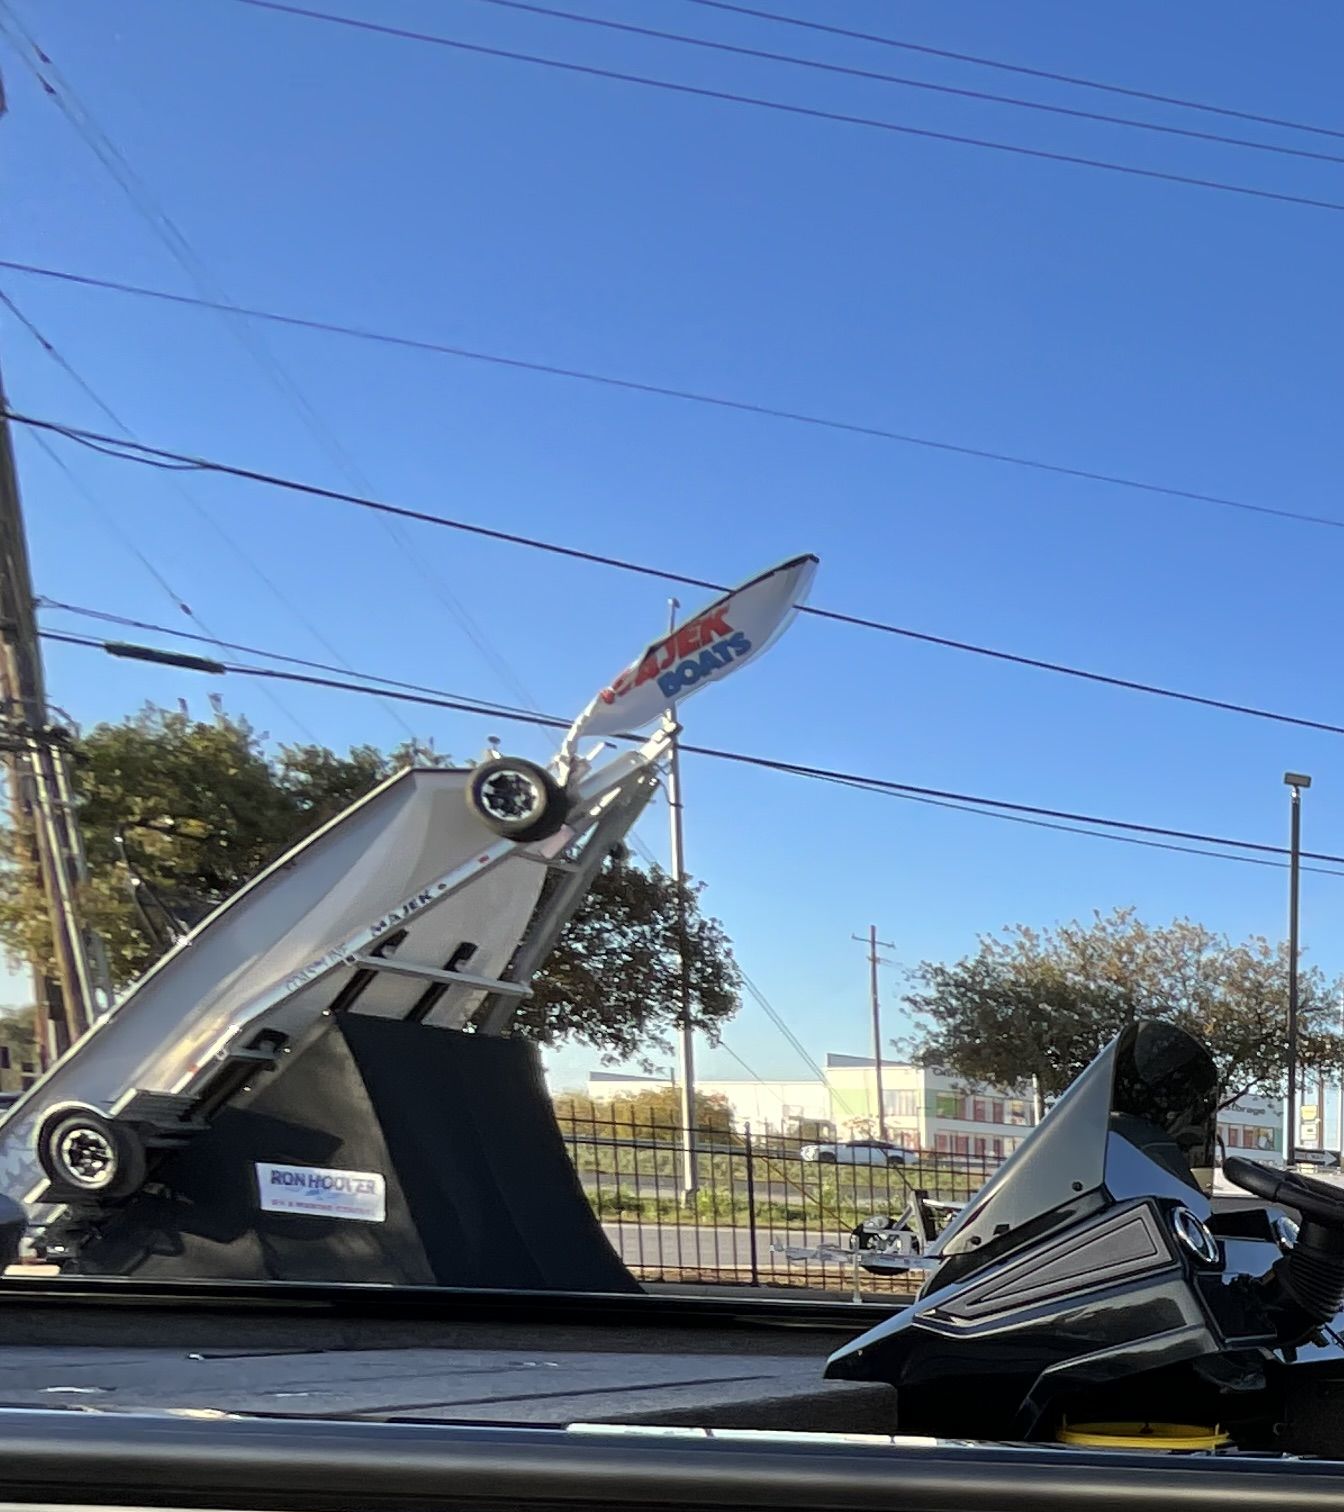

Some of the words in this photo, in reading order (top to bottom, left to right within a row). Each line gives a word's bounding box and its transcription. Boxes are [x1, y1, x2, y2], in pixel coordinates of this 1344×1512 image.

[656, 630, 753, 698] BOATS
[370, 889, 433, 938] MAJEK
[270, 1169, 306, 1187] RON
[308, 1172, 376, 1195] HOOVER
